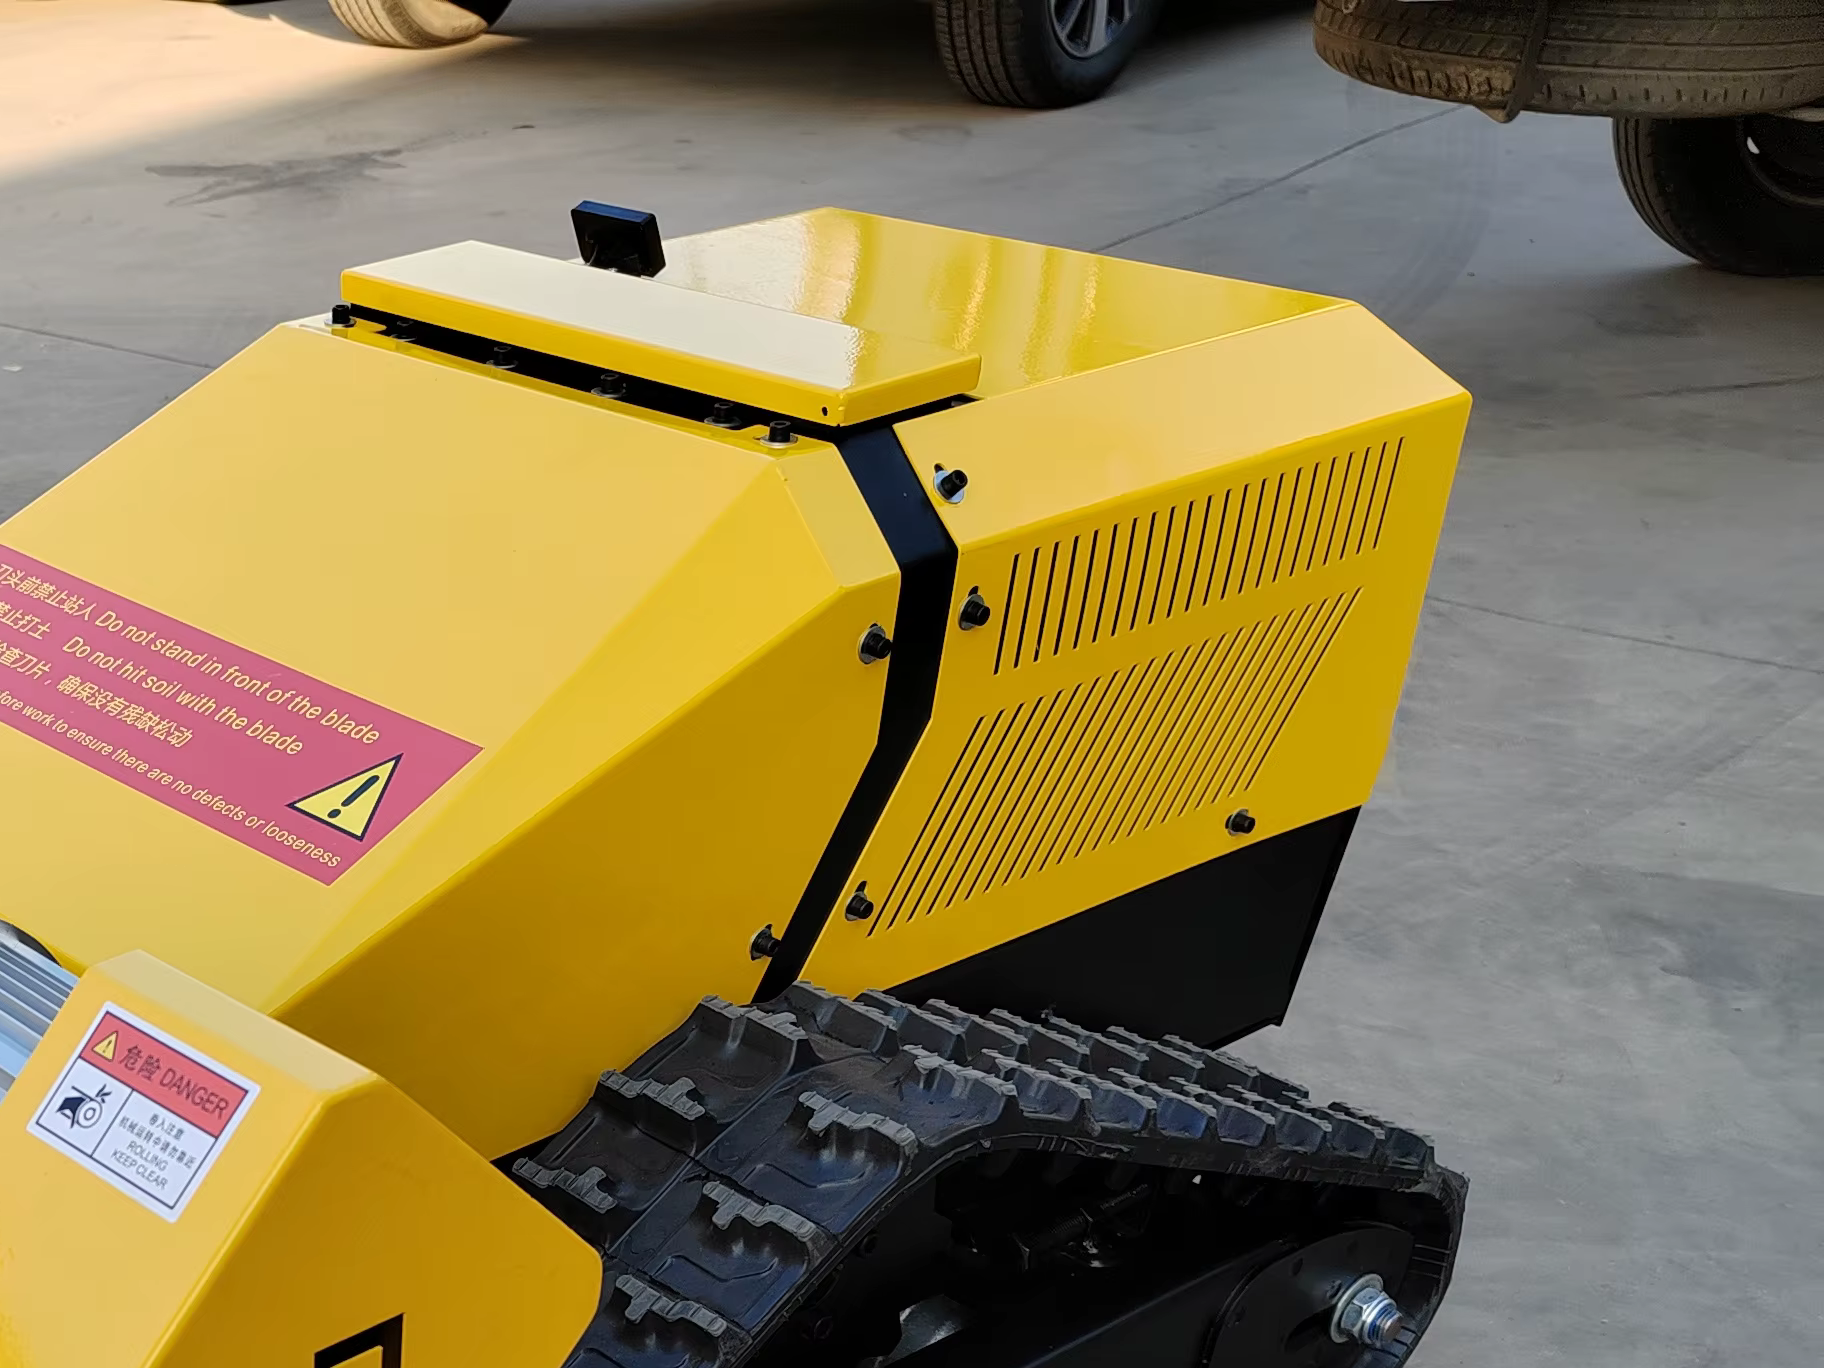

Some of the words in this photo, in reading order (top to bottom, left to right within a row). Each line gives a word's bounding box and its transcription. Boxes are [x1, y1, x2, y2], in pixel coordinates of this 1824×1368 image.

[62, 636, 92, 658] Do
[88, 650, 124, 674] not
[120, 661, 148, 684] hit
[142, 674, 182, 700] soil
[175, 689, 218, 717] with
[213, 706, 248, 731] the
[245, 718, 304, 756] blade
[95, 610, 125, 633] Do
[121, 624, 156, 647] not
[150, 635, 206, 668] stand
[201, 656, 224, 678] in
[219, 665, 271, 698] front
[266, 684, 295, 706] of
[288, 697, 321, 720] the
[320, 709, 381, 745] blade
[22, 704, 55, 727] work
[52, 717, 67, 733] to
[67, 728, 114, 756] ensure
[112, 747, 149, 774] there
[147, 767, 173, 785] are
[171, 779, 193, 796] no
[191, 788, 247, 821] defects
[244, 814, 265, 830] or
[261, 821, 341, 868] looseness
[159, 1067, 230, 1120] DANGER
[110, 1149, 138, 1169] KEEP
[135, 1163, 169, 1190] CLEAR
[126, 1140, 169, 1172] ROLLING
